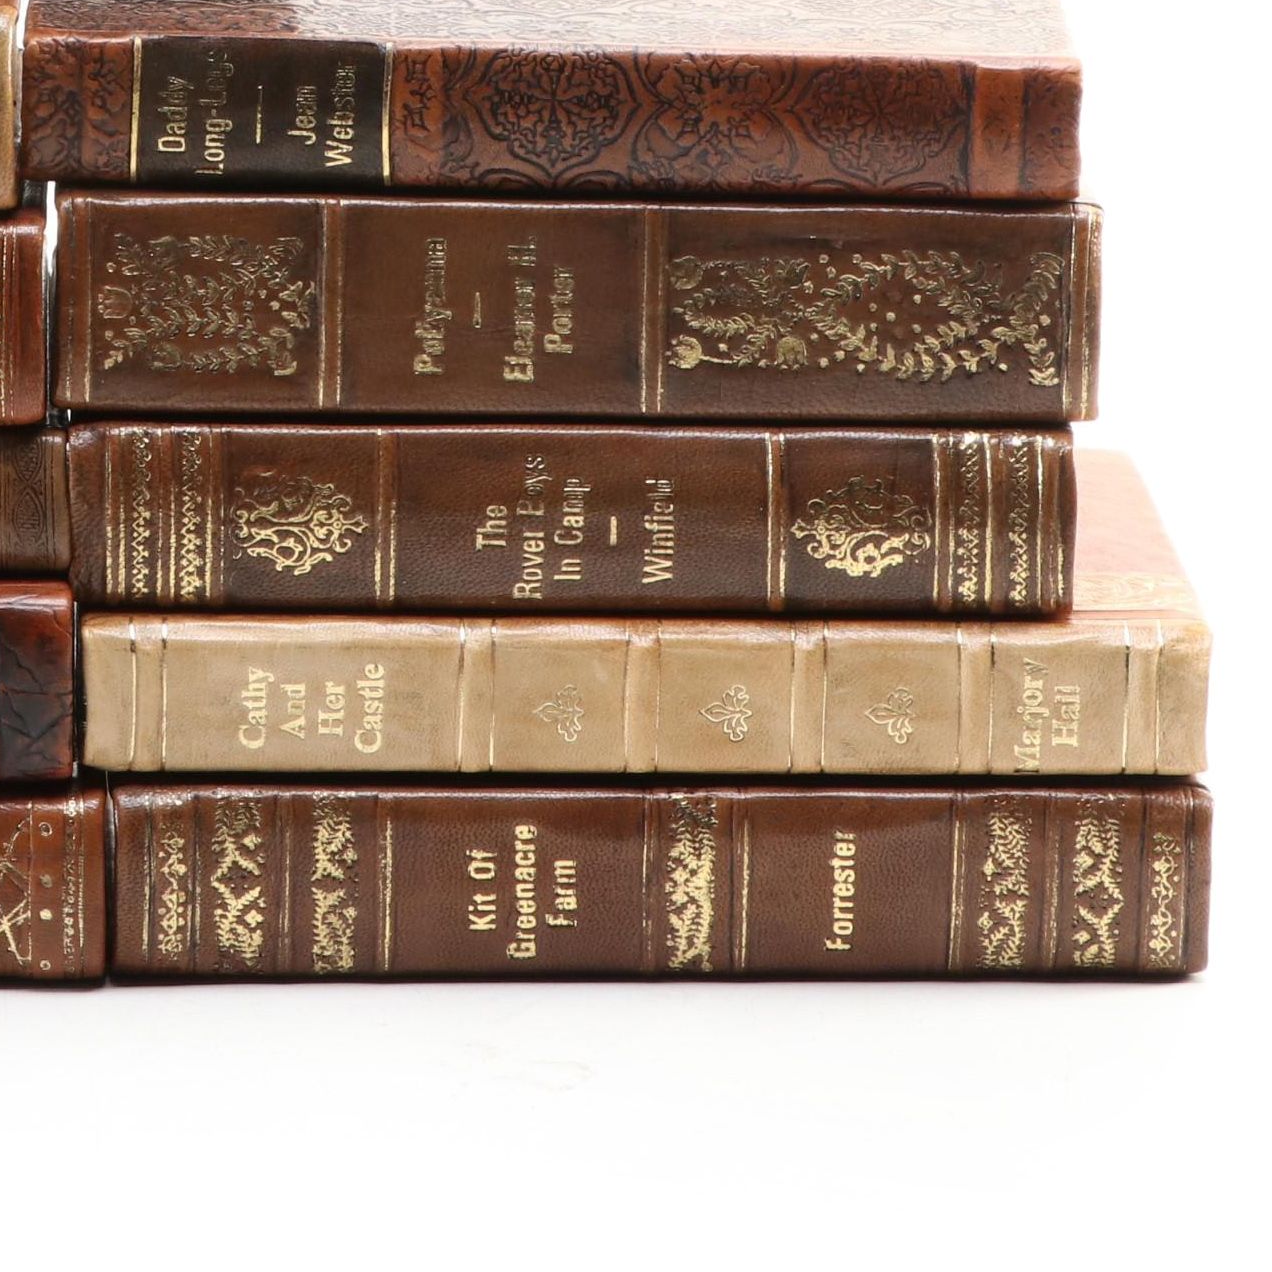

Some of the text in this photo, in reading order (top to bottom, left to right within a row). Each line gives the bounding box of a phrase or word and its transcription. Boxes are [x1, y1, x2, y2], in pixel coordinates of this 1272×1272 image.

[156, 75, 195, 154] Daddy
[195, 49, 235, 175] Long-Legs
[288, 85, 318, 146] Jean
[324, 61, 357, 168] Webster
[503, 277, 536, 383] Eleanor
[543, 264, 574, 354] Porter
[476, 505, 508, 551] The
[512, 453, 552, 599] Rover Boys
[553, 478, 591, 580] In Camp
[642, 478, 675, 584] Winfield
[238, 666, 275, 749] Cathy
[280, 682, 306, 739] And
[318, 681, 345, 737] Her
[354, 663, 385, 753] Castle
[1014, 657, 1050, 773] Marjory
[1051, 685, 1080, 748] Hall
[466, 849, 497, 930] Kit Of
[507, 824, 537, 960] Greenacre
[545, 860, 577, 927] Farm
[824, 830, 856, 950] Forrester
